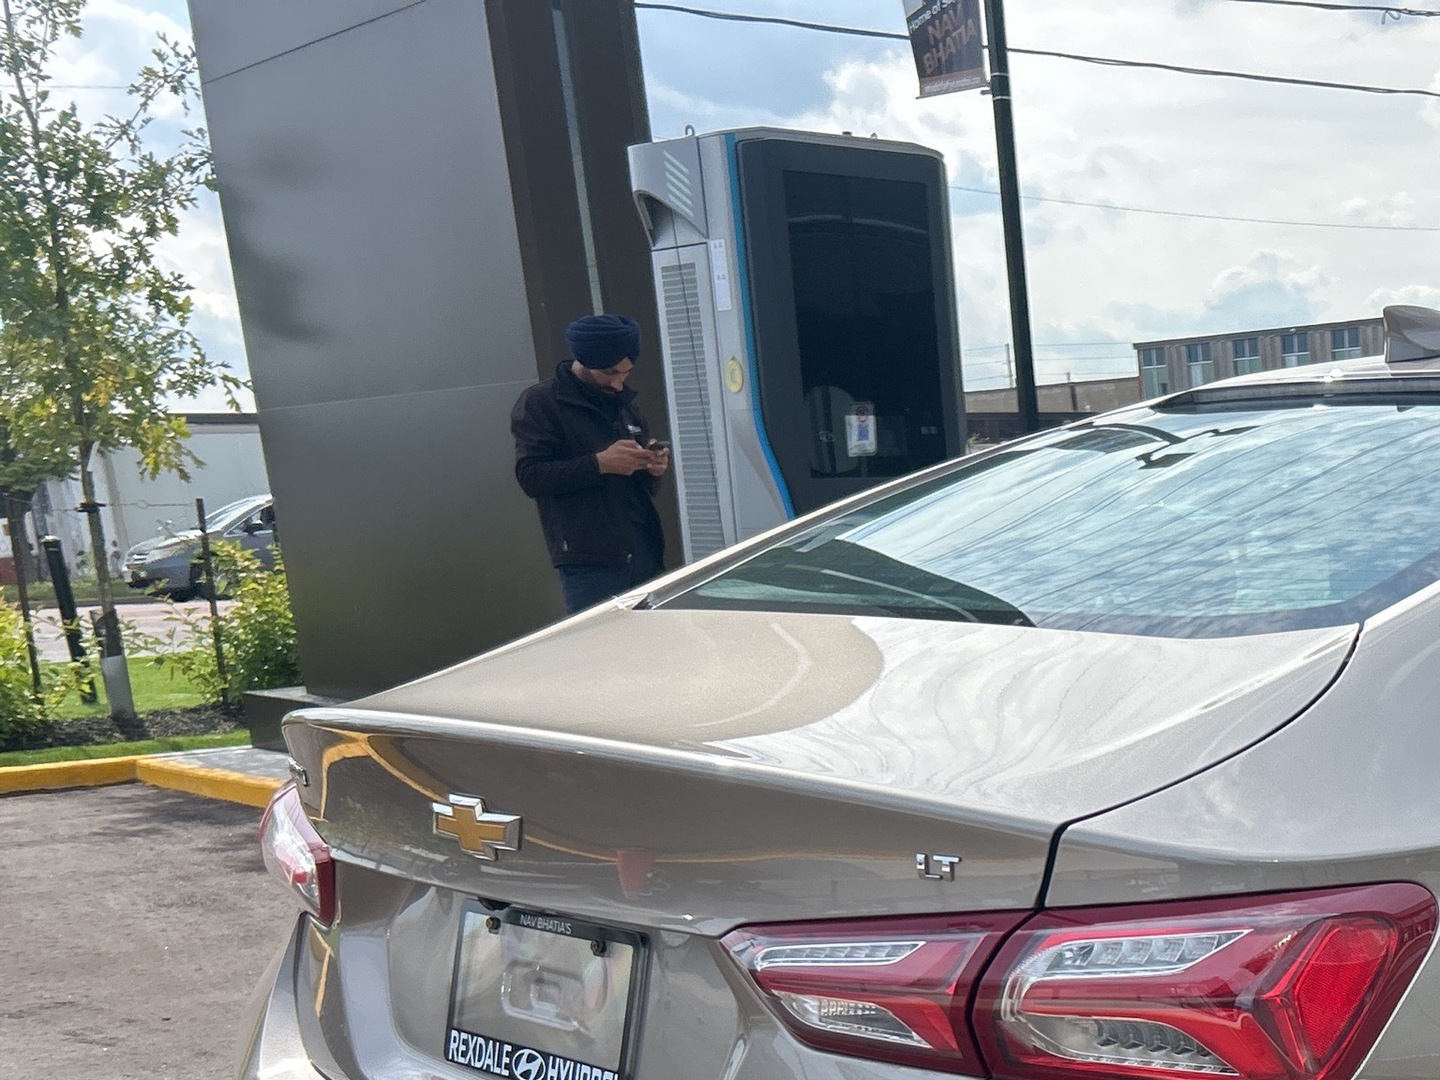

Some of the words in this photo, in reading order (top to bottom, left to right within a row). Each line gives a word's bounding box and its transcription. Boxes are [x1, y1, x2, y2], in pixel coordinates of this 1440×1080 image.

[923, 18, 978, 75] BHATIA
[916, 853, 962, 881] LT
[520, 914, 537, 928] NAV
[537, 917, 572, 935] BHATIA'S
[449, 1029, 512, 1076] REXDALE
